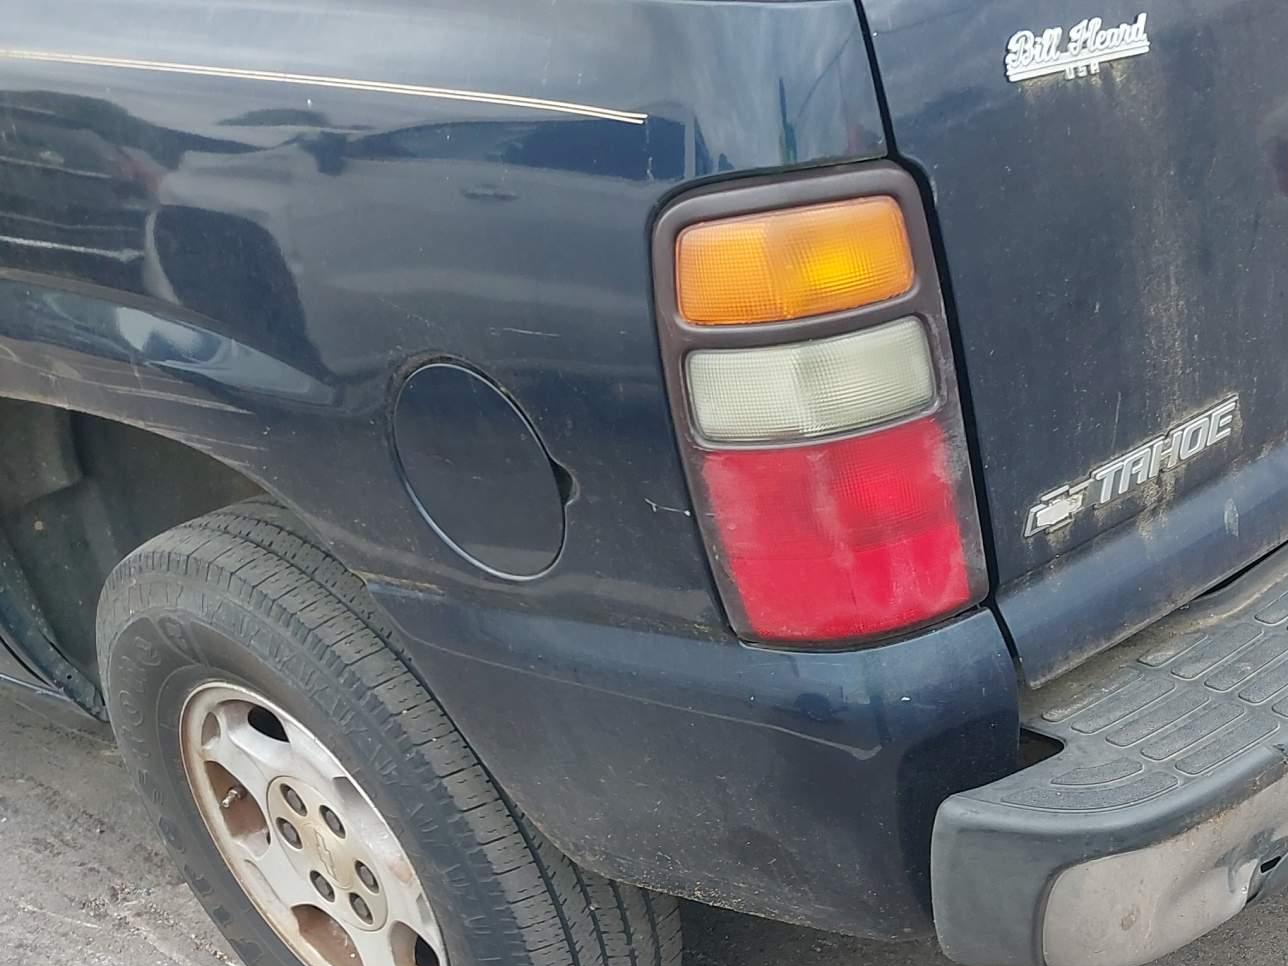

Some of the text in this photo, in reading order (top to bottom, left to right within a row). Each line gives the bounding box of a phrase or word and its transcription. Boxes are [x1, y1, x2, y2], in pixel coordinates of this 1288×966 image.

[1005, 12, 1148, 66] Bill Heard
[1065, 61, 1100, 80] USA
[1094, 400, 1237, 504] TAHOE
